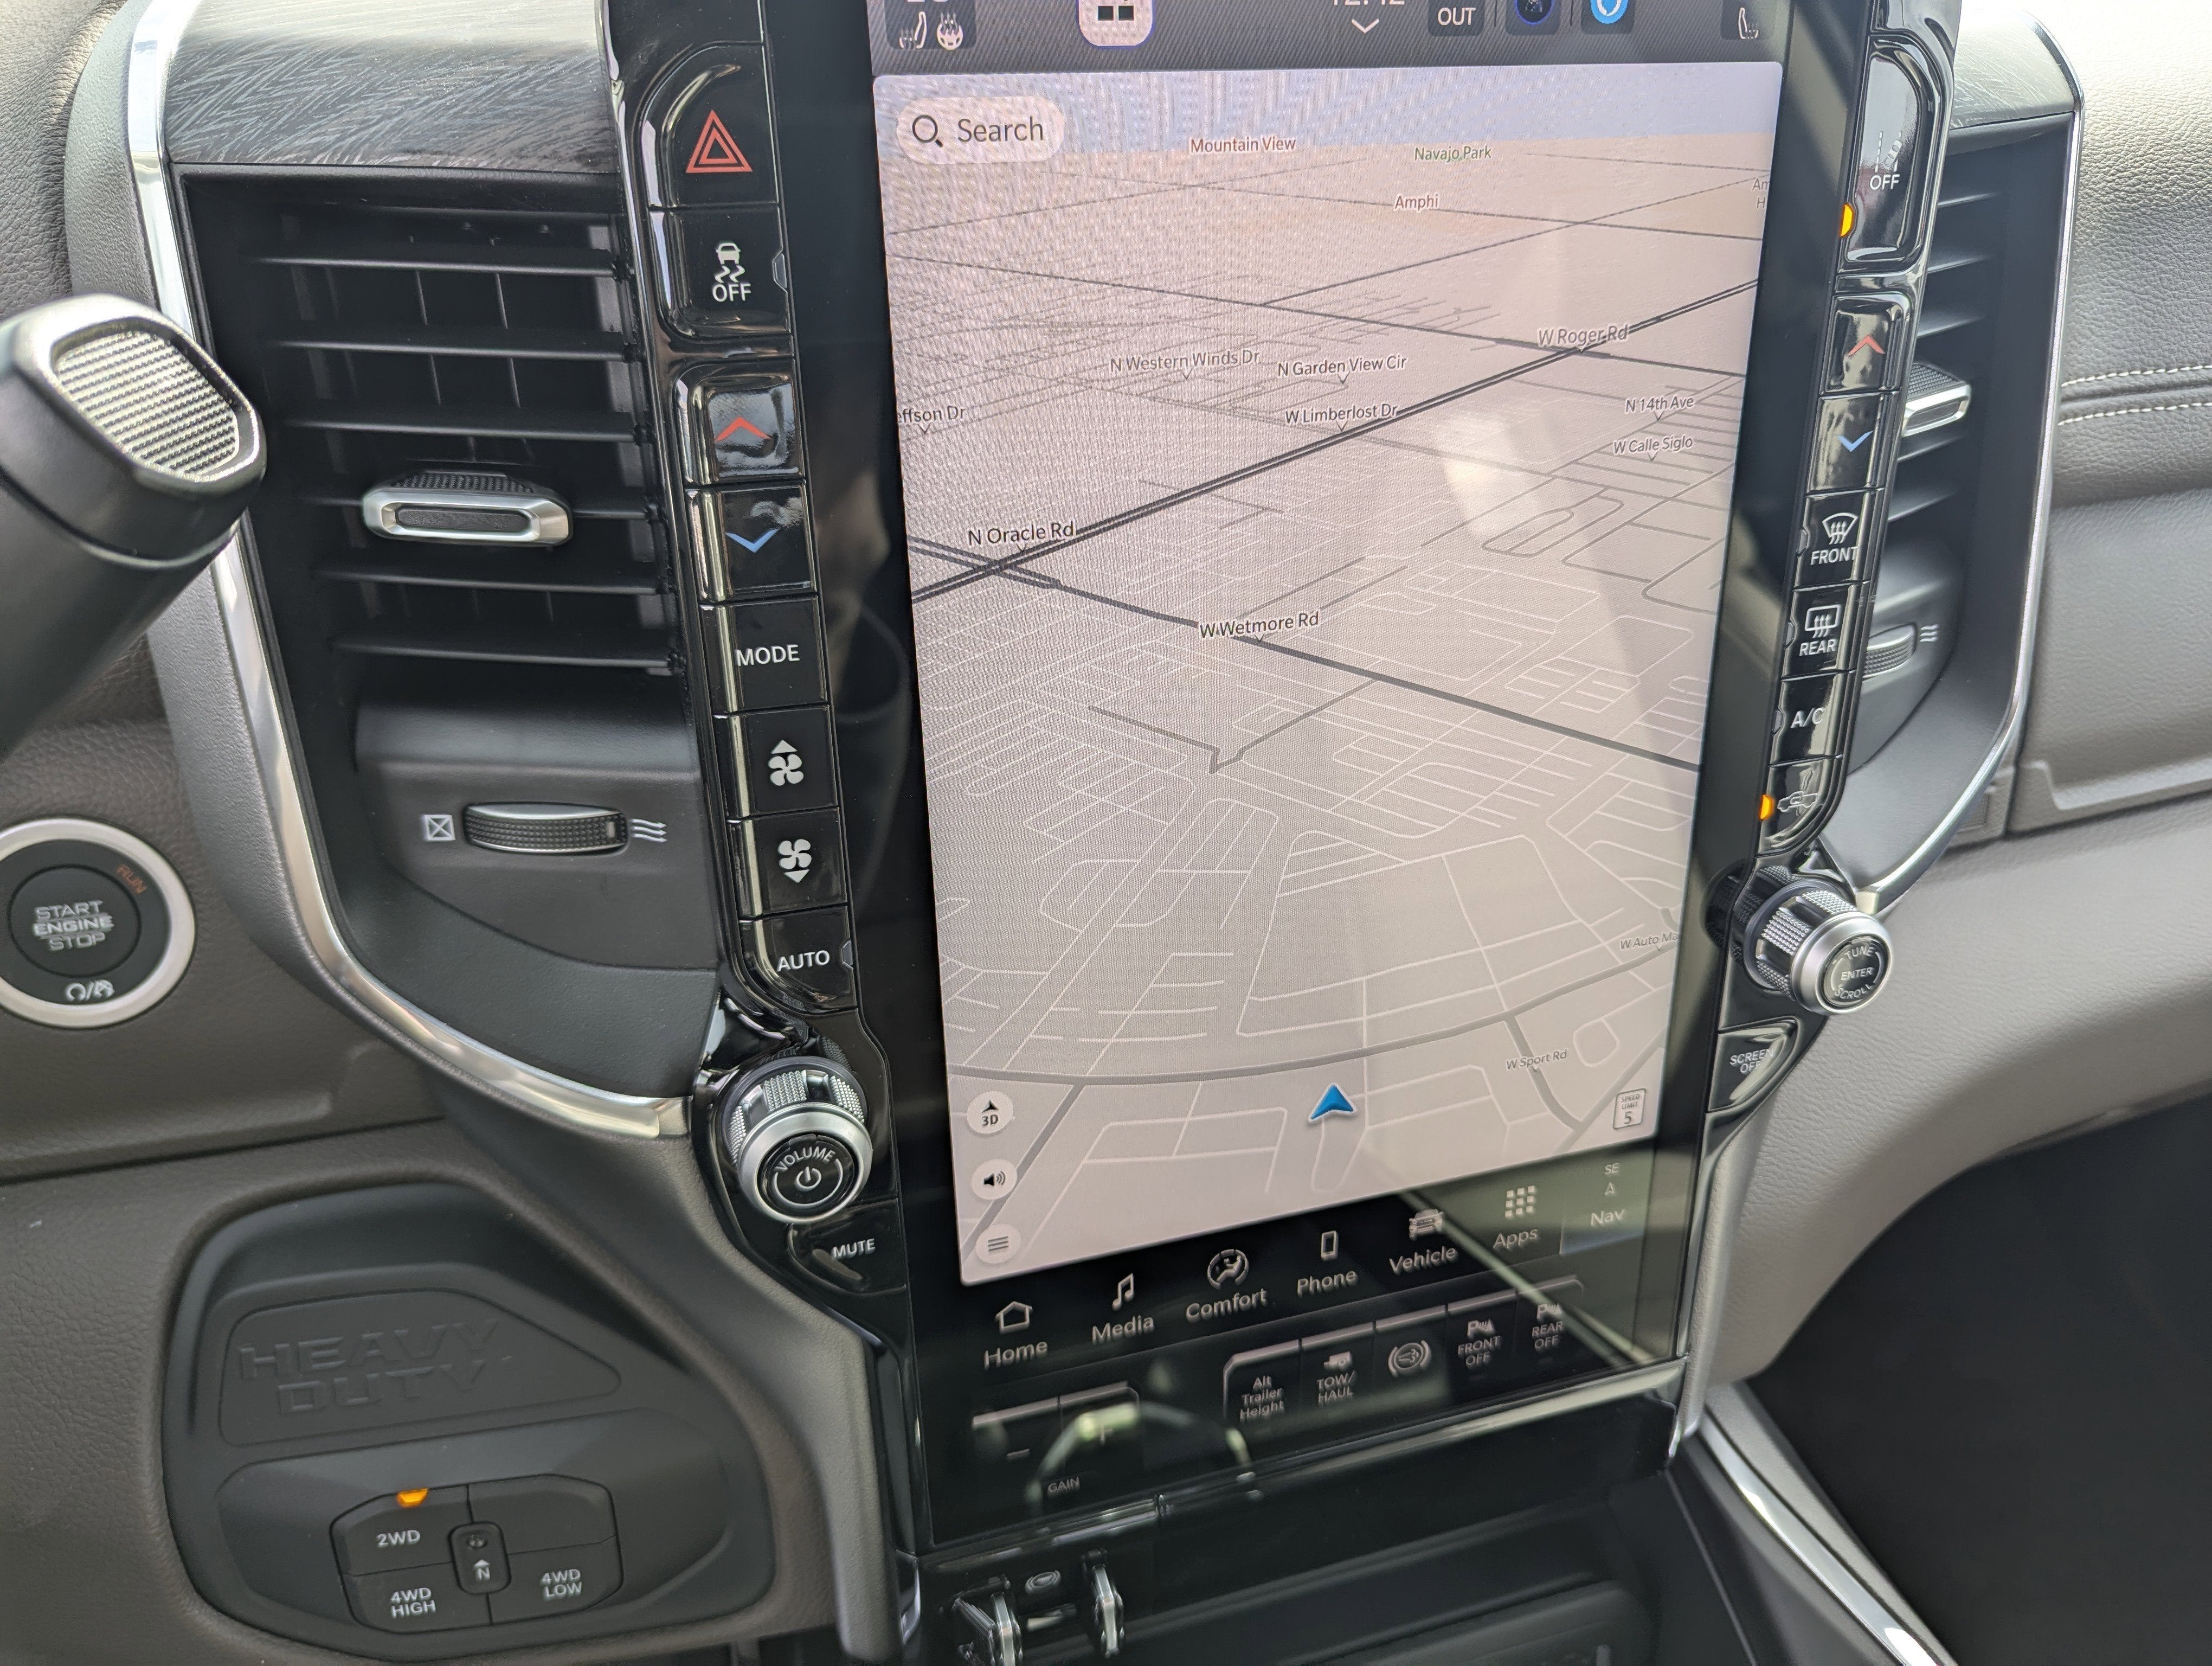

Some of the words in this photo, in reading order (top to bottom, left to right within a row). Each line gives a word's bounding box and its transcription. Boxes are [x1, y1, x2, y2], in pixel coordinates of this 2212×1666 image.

[1437, 8, 1476, 25] OUT
[957, 117, 1044, 144] Search
[1190, 138, 1259, 154] Mountain
[1262, 136, 1296, 152] View
[1414, 146, 1461, 162] Navajo
[1463, 146, 1491, 159] Park
[1870, 175, 1900, 189] OFF
[1394, 194, 1440, 211] Amphi
[712, 284, 751, 302] OFF
[1538, 329, 1555, 345] W
[1557, 327, 1602, 347] Roger
[1605, 324, 1628, 341] Rd
[1110, 359, 1122, 373] N
[1125, 354, 1189, 370] Western
[1191, 351, 1237, 367] Winds
[1241, 349, 1260, 364] Dr
[1278, 363, 1289, 377] N
[1294, 358, 1348, 374] Garden
[1349, 357, 1381, 371] View
[1383, 355, 1406, 369] Cir
[947, 405, 966, 420] Dr
[1285, 411, 1299, 424] W
[1302, 403, 1377, 421] Limberlost
[1381, 402, 1397, 417] Dr
[1626, 400, 1635, 412] N
[1638, 398, 1667, 411] 14th
[1669, 395, 1694, 409] Ave
[1613, 441, 1627, 454] W
[1629, 439, 1659, 452] Calle
[1664, 435, 1693, 452] Siglo
[968, 530, 981, 544] N
[987, 524, 1046, 542] Oracle
[1050, 522, 1074, 537] Rd
[1810, 547, 1860, 566] FRONT
[1200, 624, 1215, 638] W
[1220, 617, 1294, 636] Wetmore
[1298, 611, 1319, 627] Rd
[736, 644, 800, 667] MODE
[1799, 639, 1837, 656] REAR
[1791, 708, 1824, 729] A/C
[116, 864, 147, 894] RUN
[35, 900, 103, 920] START
[33, 915, 114, 937] ENGINE
[48, 932, 106, 951] STOP
[1620, 939, 1631, 950] W
[1632, 936, 1659, 948] Auto
[776, 950, 830, 971] AUTO
[1844, 945, 1875, 961] TUNE
[1841, 967, 1874, 981] ENTER
[1835, 984, 1873, 1000] SCROLL
[1506, 1059, 1519, 1069] W
[1520, 1053, 1551, 1068] Sport
[1552, 1049, 1567, 1061] Rd
[1729, 1049, 1773, 1066] SCREEN
[1740, 1063, 1762, 1074] OFF
[1621, 1093, 1641, 1103] SPEED
[1621, 1101, 1639, 1110] LIMIT
[982, 1114, 999, 1126] 3D
[1623, 1111, 1632, 1125] 5
[775, 1145, 837, 1172] VOLUME
[1604, 1162, 1619, 1175] SE
[1591, 1208, 1625, 1226] Nav
[832, 1238, 876, 1259] MUTE
[1493, 1228, 1539, 1252] Apps
[1389, 1246, 1458, 1276] Vehicle
[1297, 1269, 1357, 1297] Phone
[1186, 1288, 1268, 1322] Comfort
[1092, 1315, 1155, 1345] Media
[1532, 1321, 1564, 1338] REAR
[240, 1319, 499, 1380] HEAVY
[1457, 1335, 1501, 1358] FRONT
[1534, 1334, 1559, 1351] OFF
[984, 1340, 1048, 1369] Home
[1465, 1351, 1491, 1369] OFF
[278, 1360, 486, 1414] DUTY
[1252, 1375, 1271, 1392] Alt
[1316, 1370, 1356, 1391] TOW/
[1242, 1387, 1284, 1409] Trailer
[1317, 1386, 1354, 1404] HAUL
[1239, 1400, 1285, 1421] Height
[1047, 1476, 1080, 1495] GAIN
[377, 1529, 420, 1548] 2WD
[477, 1568, 490, 1580] N
[541, 1569, 581, 1586] 4WD
[390, 1587, 432, 1605] 4WD
[544, 1582, 582, 1599] LOW
[390, 1600, 436, 1618] HIGH
